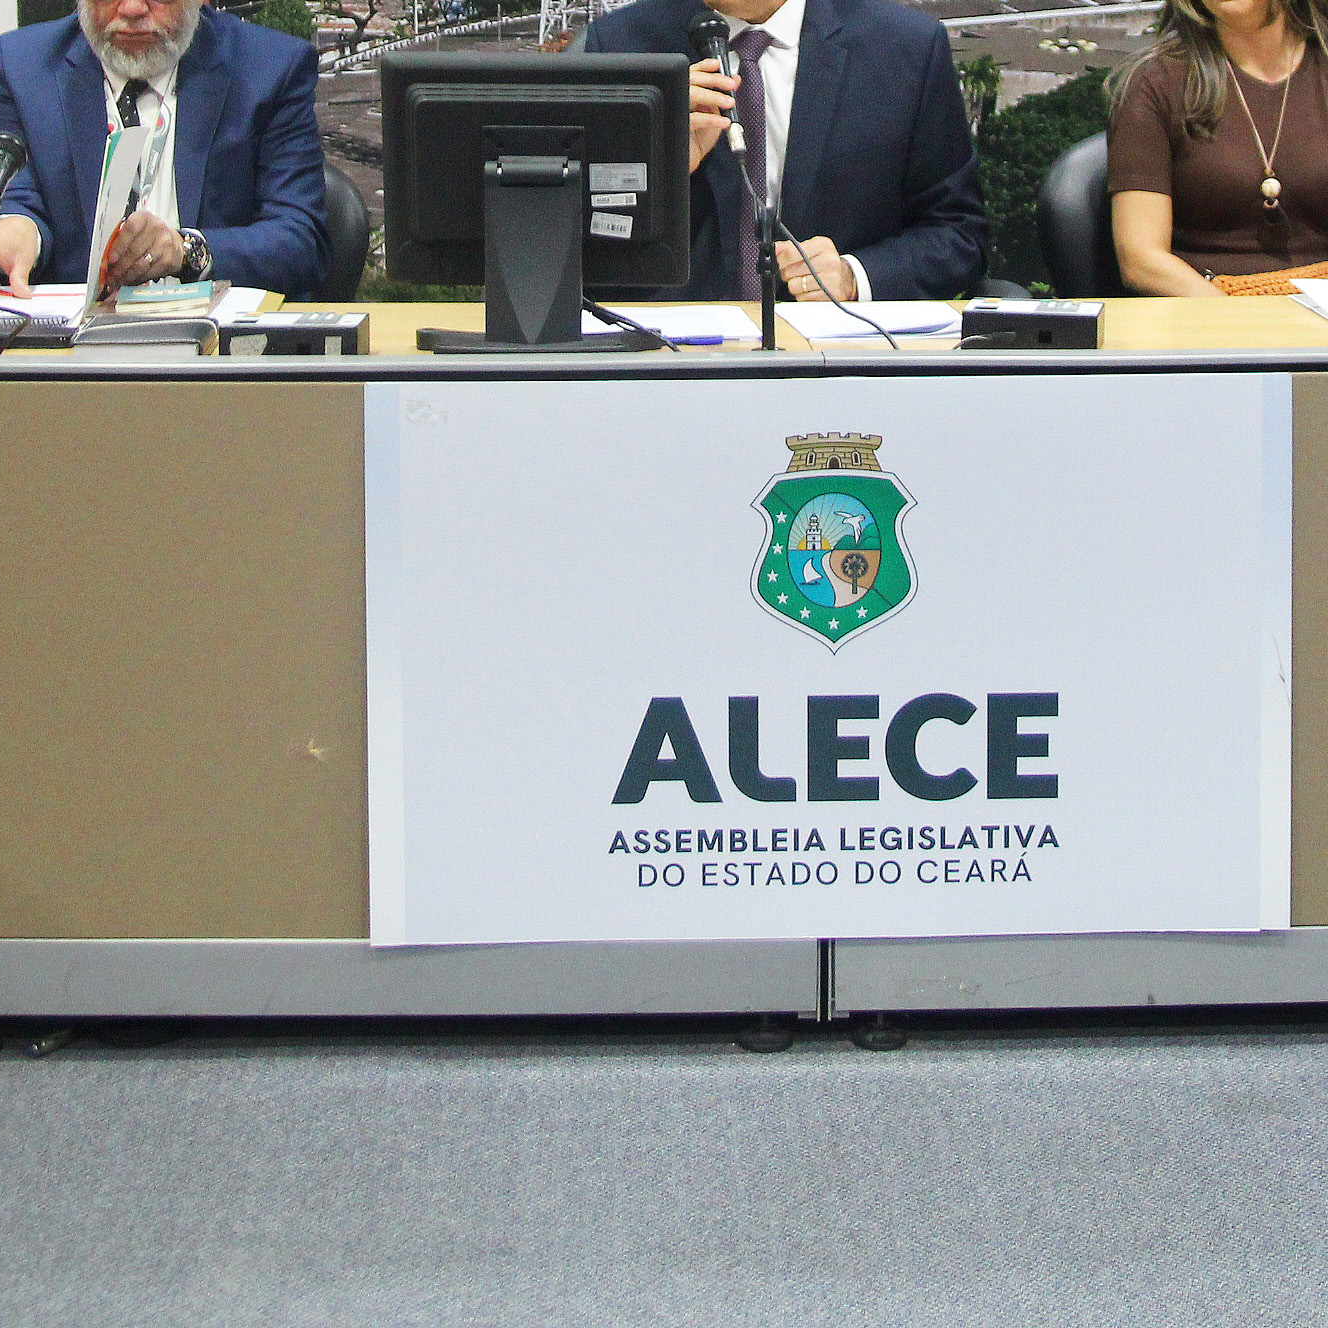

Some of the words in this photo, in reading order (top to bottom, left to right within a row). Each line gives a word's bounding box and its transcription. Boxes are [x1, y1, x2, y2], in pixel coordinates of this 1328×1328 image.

[611, 691, 1060, 804] ALECE
[608, 826, 827, 855] ASSEMBLEIA
[840, 824, 1060, 852] LEGISLATIVA
[638, 862, 686, 886] DO
[702, 860, 839, 886] ESTADO
[854, 860, 901, 884] DO
[917, 851, 1033, 883] CEARÁ
